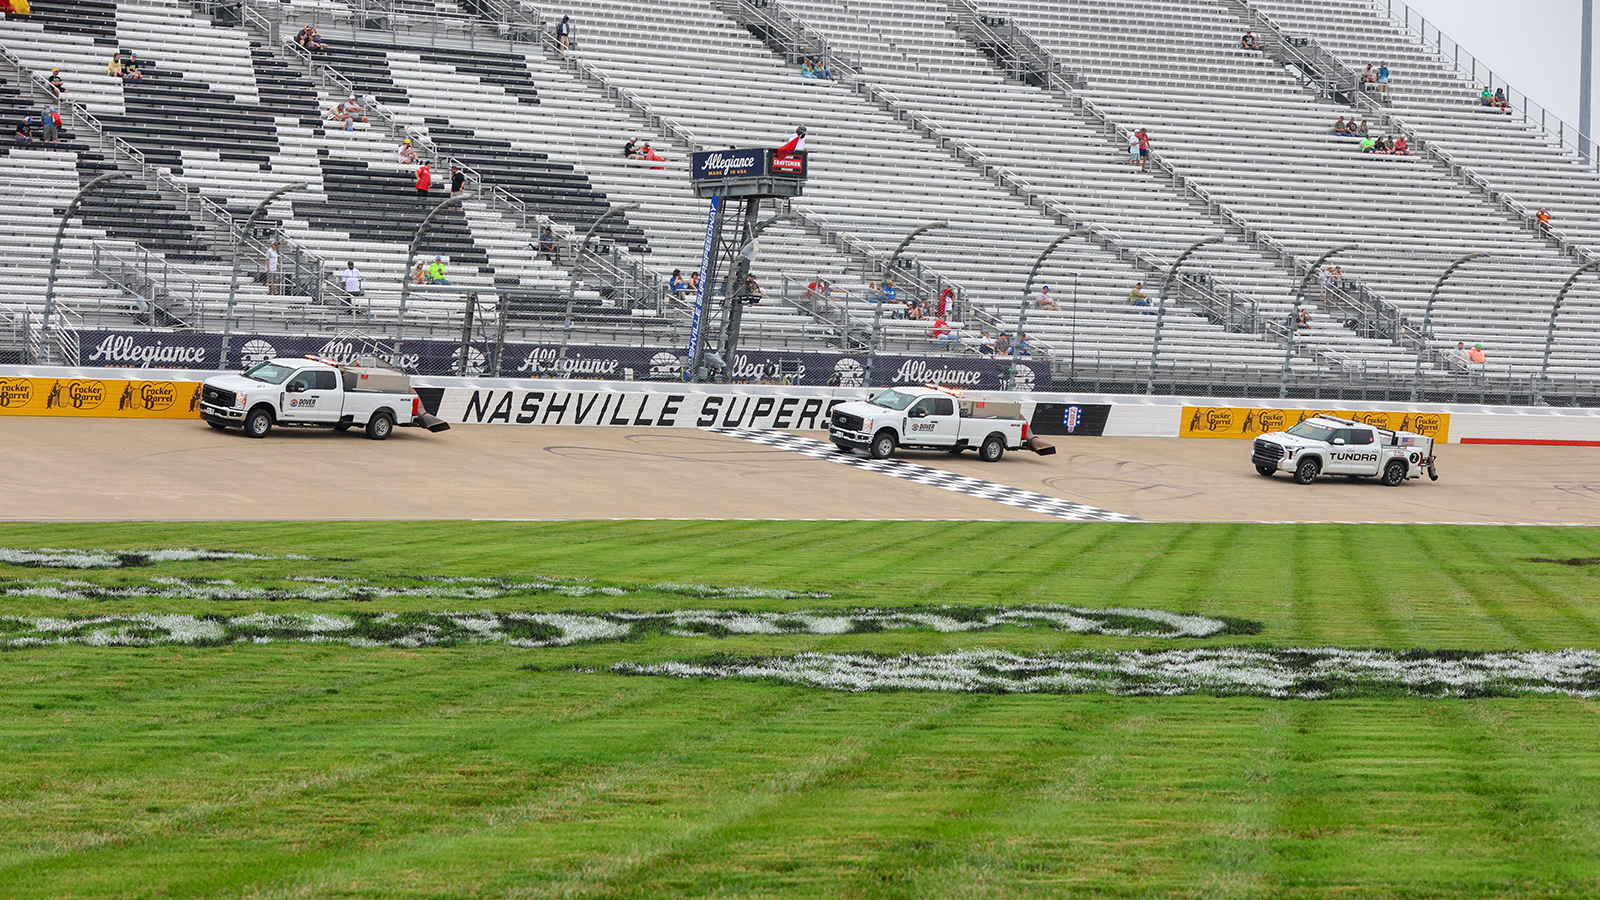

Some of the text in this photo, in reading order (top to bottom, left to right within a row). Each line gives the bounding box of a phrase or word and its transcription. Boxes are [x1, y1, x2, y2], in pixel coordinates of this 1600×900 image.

[701, 153, 755, 175] Allegiance
[773, 159, 801, 167] CRAFTSMAN
[697, 203, 717, 306] SUPERSPEEDWAY
[89, 334, 205, 369] Allegiance
[892, 359, 981, 387] Allegiance
[1, 391, 30, 407] Barrel
[69, 382, 102, 400] Cracker
[141, 384, 173, 401] Cracker
[73, 393, 102, 409] Barrel
[145, 394, 173, 410] Barrel
[462, 390, 685, 427] NASHVILLE
[1206, 410, 1231, 424] Cracker
[1209, 418, 1231, 431] Barrel
[1259, 411, 1283, 425] Cracker
[1415, 415, 1438, 429] Cracker
[1262, 420, 1283, 432] Barrel
[1418, 424, 1438, 435] Barrel
[1329, 452, 1378, 462] TUNDRA
[1411, 453, 1417, 462] 2
